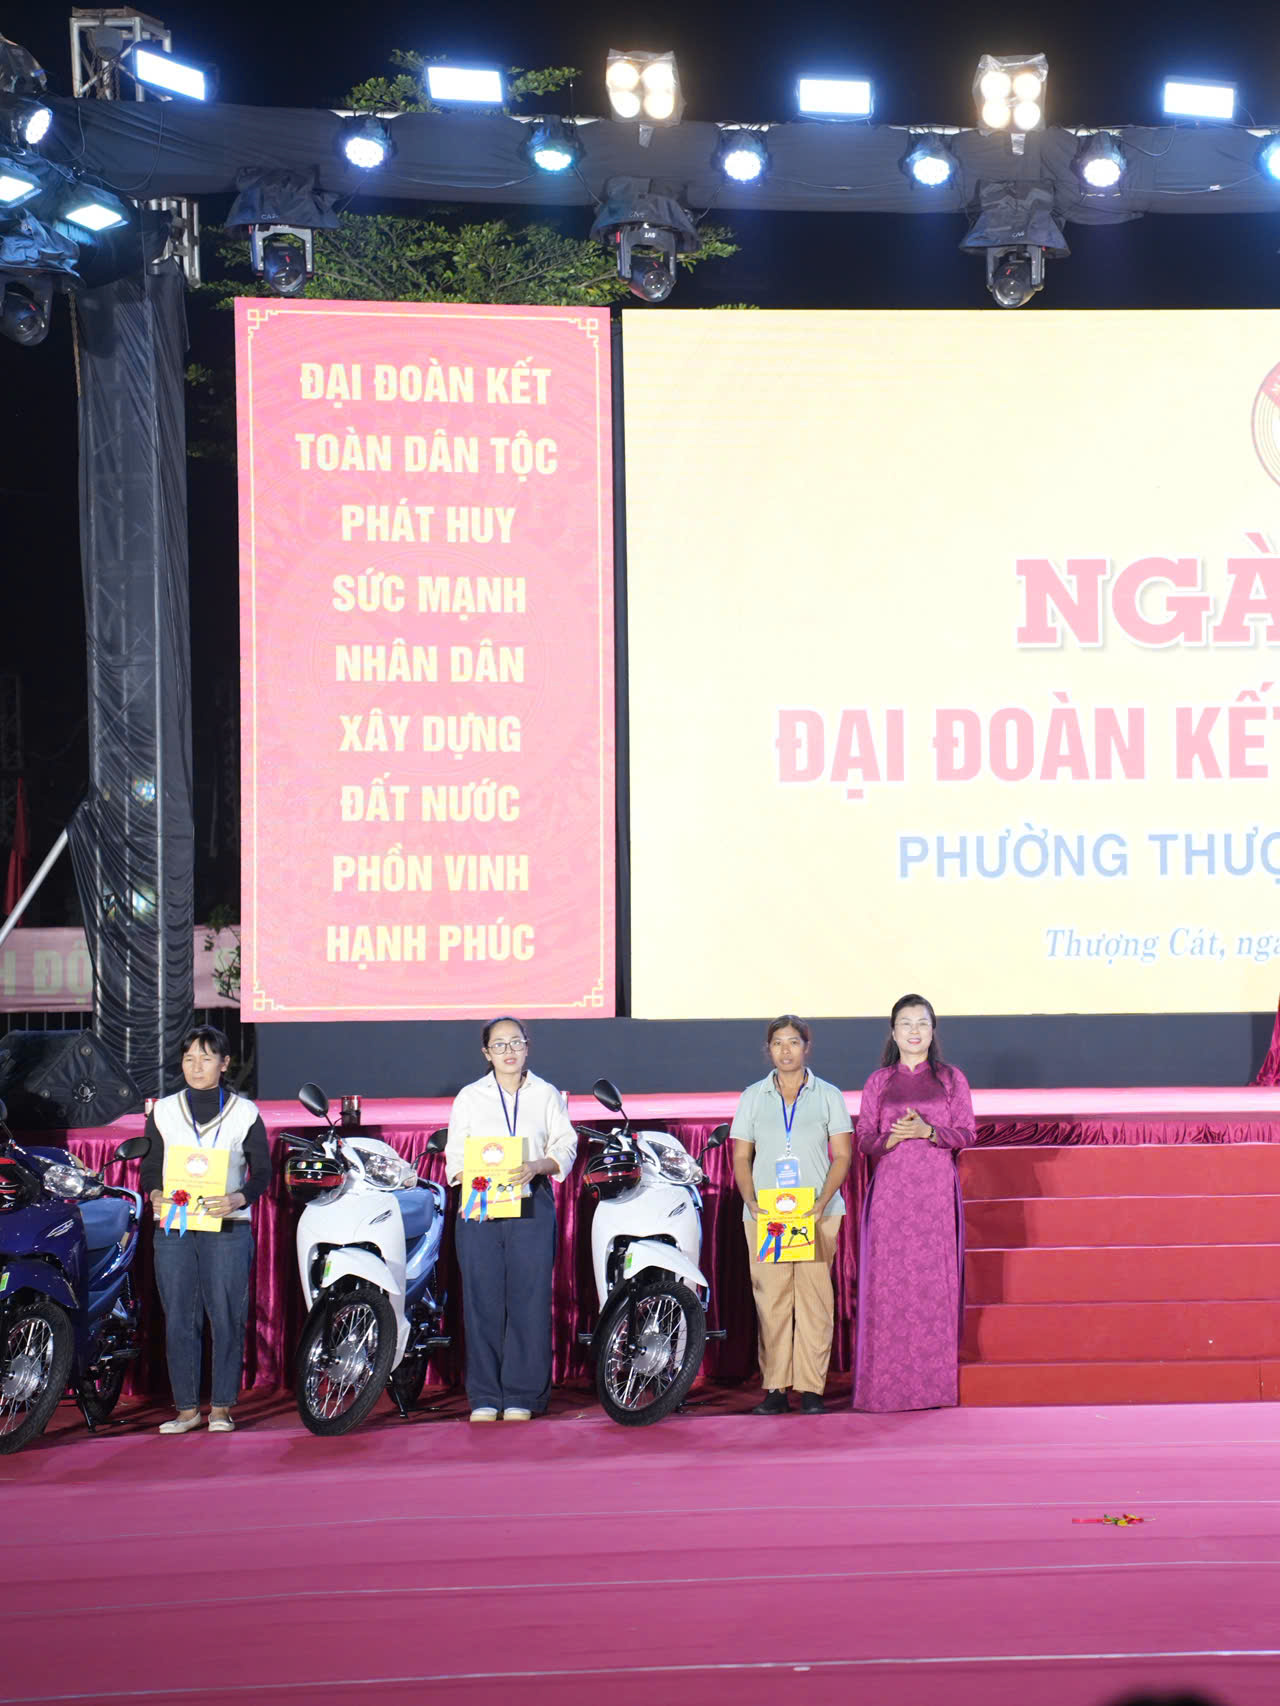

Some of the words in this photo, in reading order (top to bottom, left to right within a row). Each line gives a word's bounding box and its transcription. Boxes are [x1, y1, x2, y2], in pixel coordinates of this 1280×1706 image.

[300, 364, 361, 408] ĐẠI
[374, 358, 473, 403] ĐOÀN
[487, 356, 551, 405] KẾT
[296, 427, 391, 473] TOÀN
[405, 428, 478, 473] DÂN
[490, 428, 558, 483] TỘC
[341, 498, 434, 543] PHÁT
[447, 507, 515, 543] HUY
[333, 566, 405, 613] SỨC
[418, 576, 526, 620] MẠNH
[336, 638, 437, 682] NHÂN
[451, 638, 524, 683] DÂN
[339, 708, 410, 752] XÂY
[423, 711, 521, 760] DỰNG
[775, 706, 905, 799] ĐẠI
[932, 691, 1145, 782] ĐOÀN
[341, 771, 410, 822] ĐẤT
[422, 778, 520, 823] NƯỚC
[333, 843, 433, 892] PHỒN
[445, 855, 529, 892] VINH
[899, 823, 1128, 879] PHƯỜNG
[327, 924, 427, 971] HẠNH
[439, 917, 535, 962] PHÚC
[1046, 929, 1160, 965] Thượng
[1169, 927, 1225, 958] Cát,
